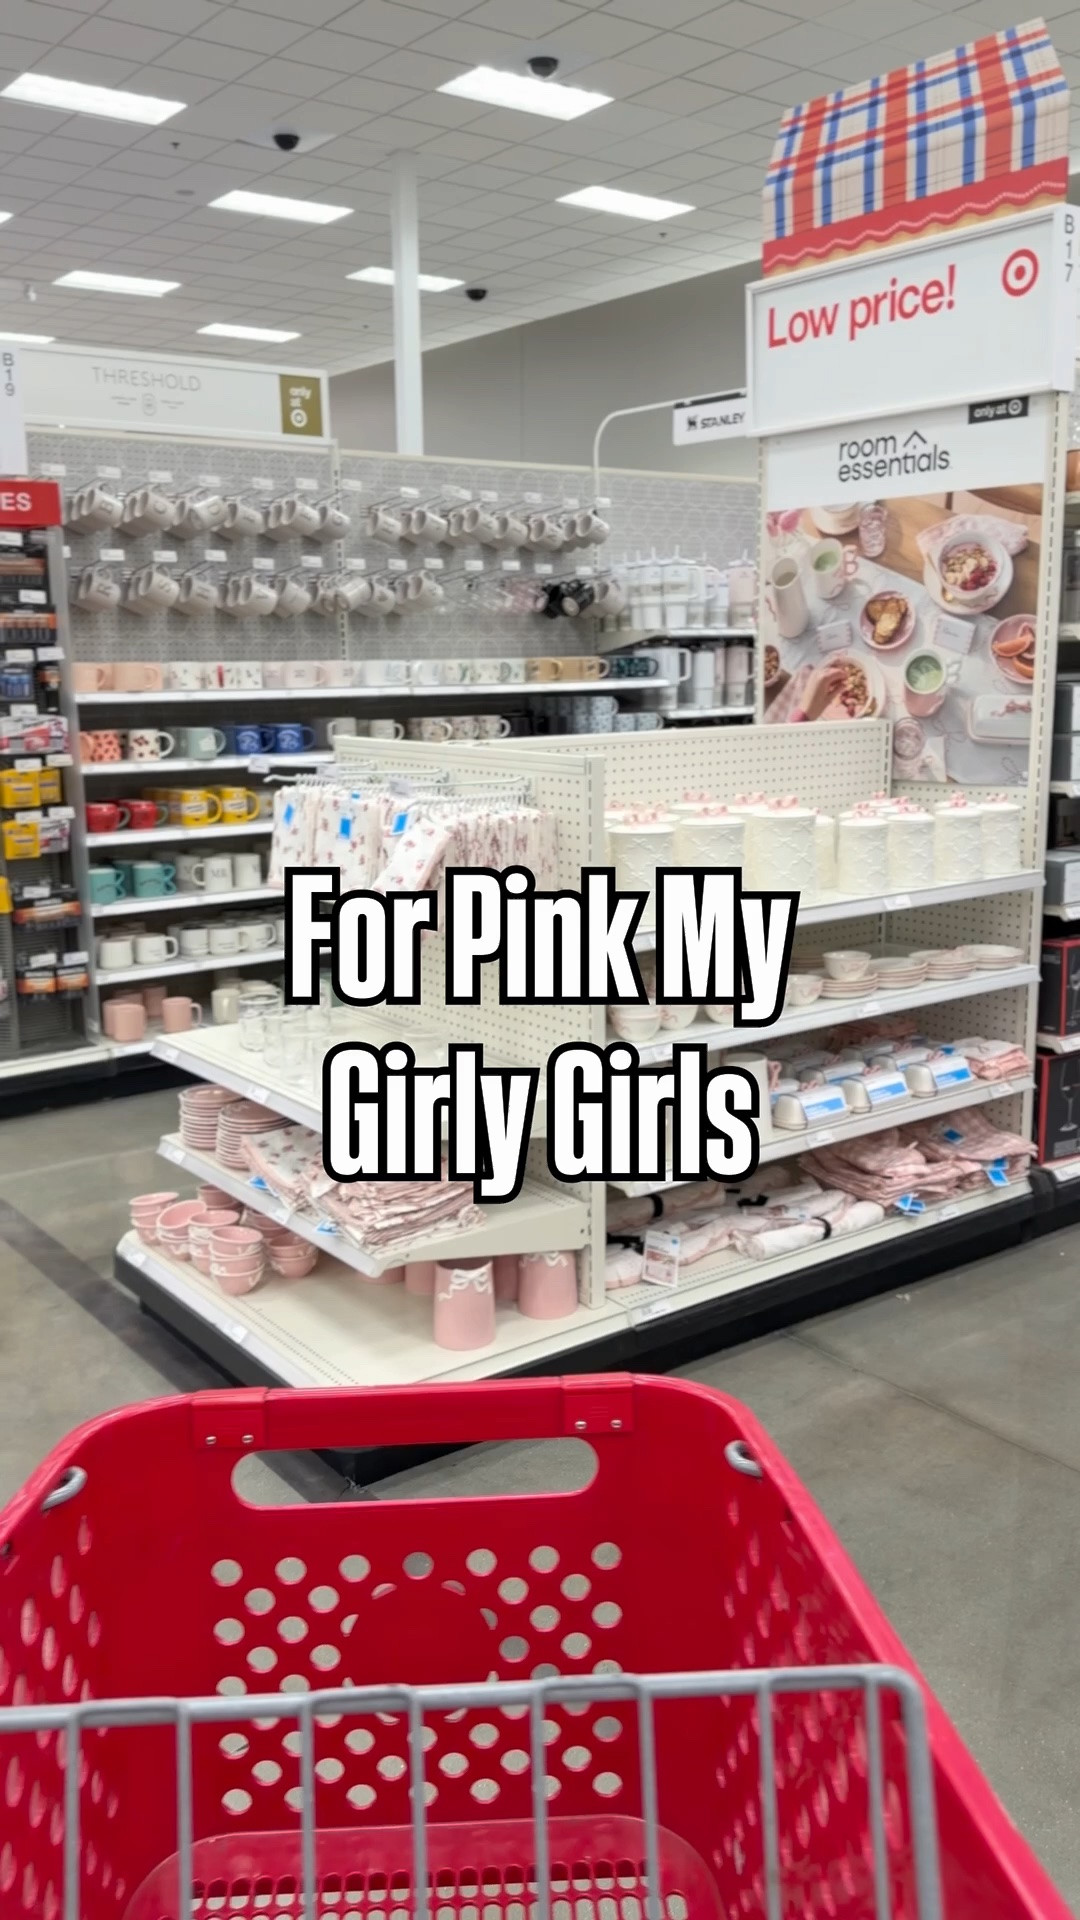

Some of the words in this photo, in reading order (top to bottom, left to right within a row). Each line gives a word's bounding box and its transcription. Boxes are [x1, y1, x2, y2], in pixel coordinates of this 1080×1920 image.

[768, 307, 839, 348] Low
[849, 264, 956, 341] price!
[91, 366, 202, 391] THRESHOLD
[701, 412, 746, 430] STANLEY
[973, 403, 995, 419] only
[838, 434, 897, 461] room
[838, 443, 950, 482] essentials
